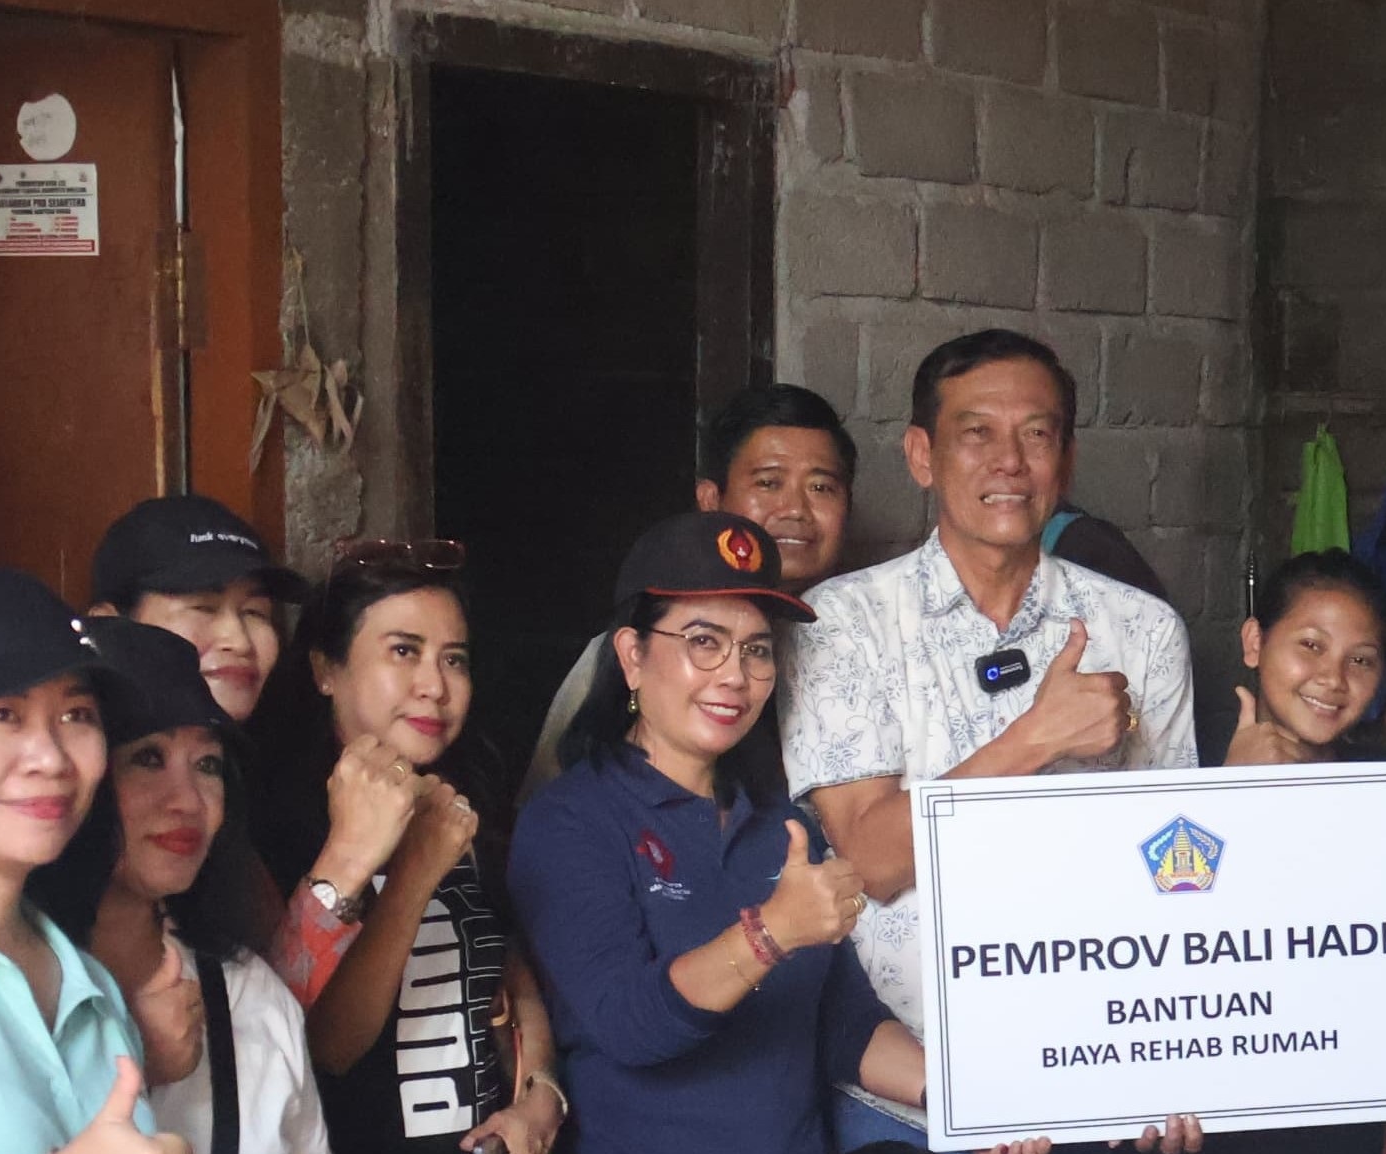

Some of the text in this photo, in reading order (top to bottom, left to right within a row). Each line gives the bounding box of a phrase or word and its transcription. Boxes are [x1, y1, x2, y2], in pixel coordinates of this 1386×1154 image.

[952, 934, 1170, 979] PEMPROV
[1184, 928, 1273, 965] BALI
[396, 898, 473, 1139] PUM
[1107, 990, 1273, 1025] BANTUAN
[1042, 1029, 1339, 1068] BIAYA REHAB RUMAH
